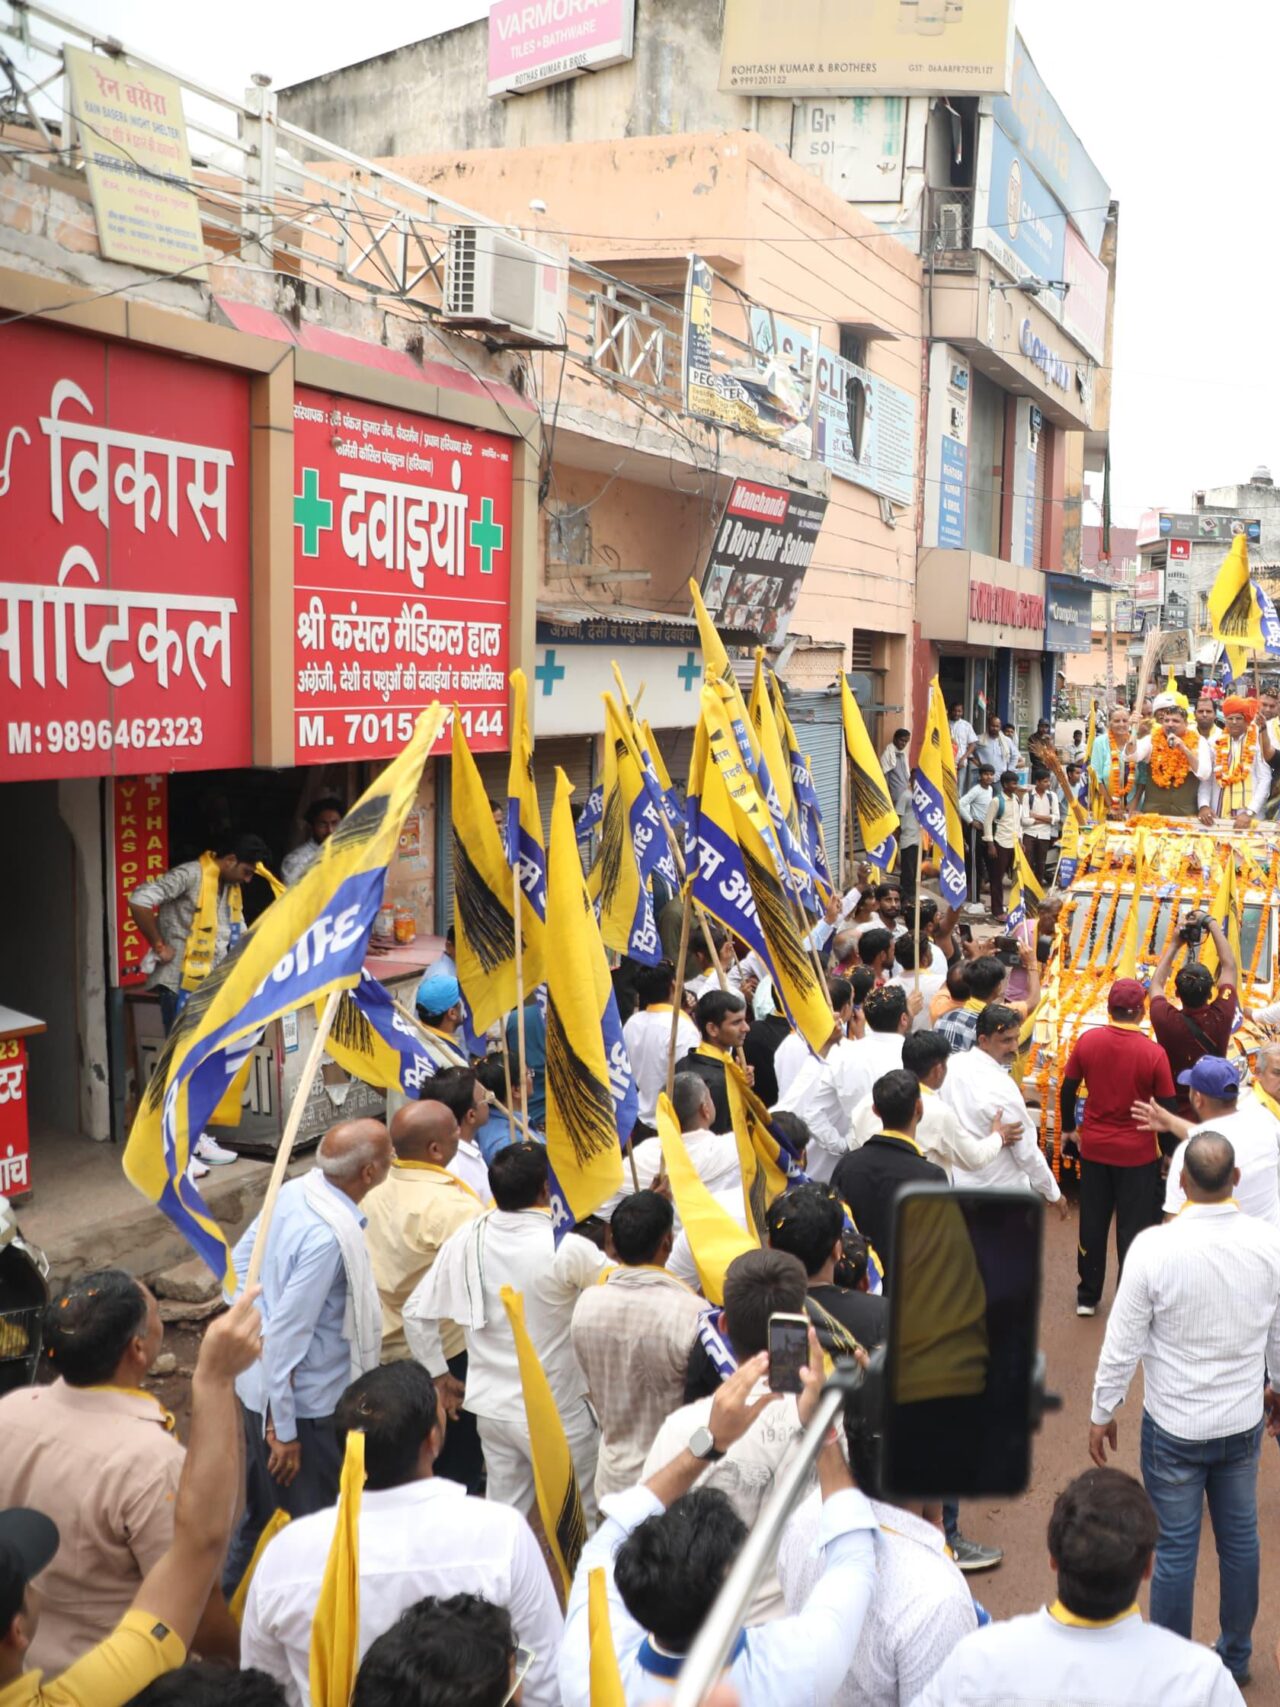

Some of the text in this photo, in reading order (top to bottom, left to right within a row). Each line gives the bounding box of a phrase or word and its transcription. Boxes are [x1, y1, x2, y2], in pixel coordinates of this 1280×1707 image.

[510, 19, 597, 60] TILES BATHWARE
[540, 63, 562, 78] KUMAR
[731, 62, 877, 75] ROHTASH KUMAR & BROTHERS
[38, 379, 235, 544] विकास
[732, 485, 787, 517] Manchanda
[339, 460, 468, 588] दवाइयां
[717, 519, 815, 567] B Boys Hair Saloon
[297, 596, 502, 658] श्री कंसल मैडिकल हाल
[339, 661, 361, 692] देशी
[362, 673, 371, 691] व
[372, 662, 401, 702] पशुओं
[402, 662, 417, 692] की
[452, 672, 460, 691] व
[299, 716, 334, 747] M.
[120, 787, 138, 853] VIKAS
